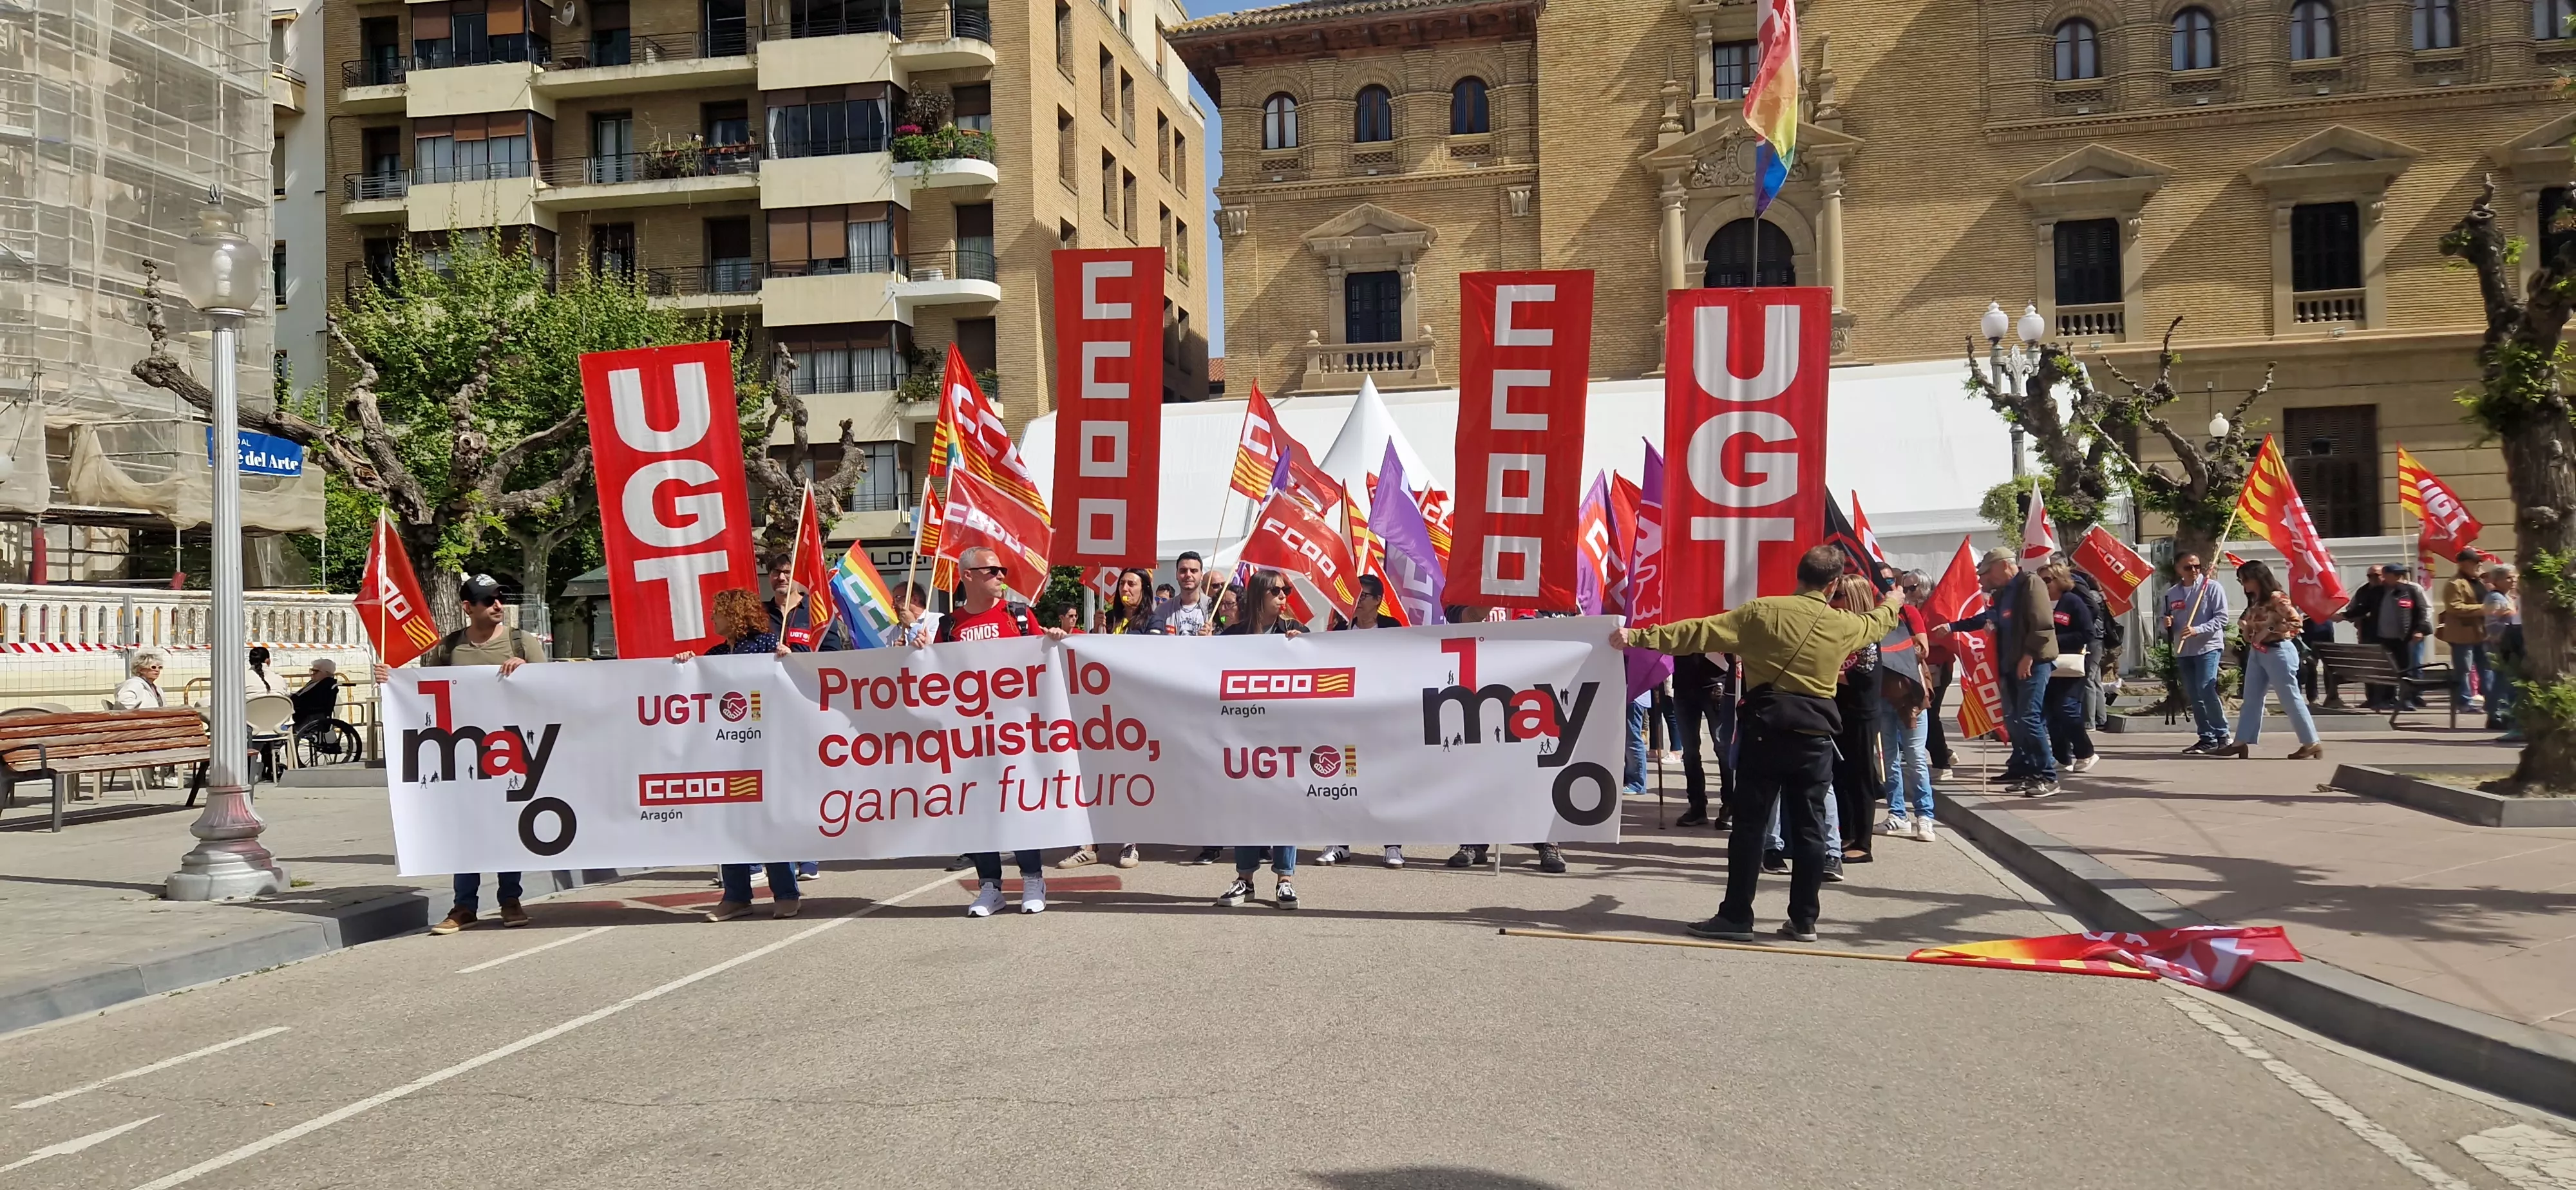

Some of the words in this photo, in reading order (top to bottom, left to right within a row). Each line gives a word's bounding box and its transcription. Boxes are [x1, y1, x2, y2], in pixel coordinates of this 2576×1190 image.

[1077, 260, 1133, 556] CCOO
[1480, 284, 1557, 598] CCOO
[1686, 304, 1801, 611] UGT
[245, 451, 267, 467] del
[269, 454, 299, 471] Arte
[607, 361, 730, 642] UGT
[1262, 516, 1337, 579] CCOO
[960, 624, 999, 641] SOMOS
[817, 663, 1046, 717] Proteger
[1066, 648, 1111, 695] lo
[1226, 674, 1312, 694] CCOO
[637, 693, 713, 726] UGT
[1220, 703, 1266, 719] Aragón
[715, 727, 762, 743] Aragón
[817, 704, 1160, 775] conquistado,
[1223, 746, 1302, 780] UGT
[645, 777, 726, 800] CCOO
[818, 780, 977, 838] ganar
[999, 765, 1155, 813] futuro
[1305, 783, 1358, 800] Aragón
[640, 809, 683, 824] Aragón
